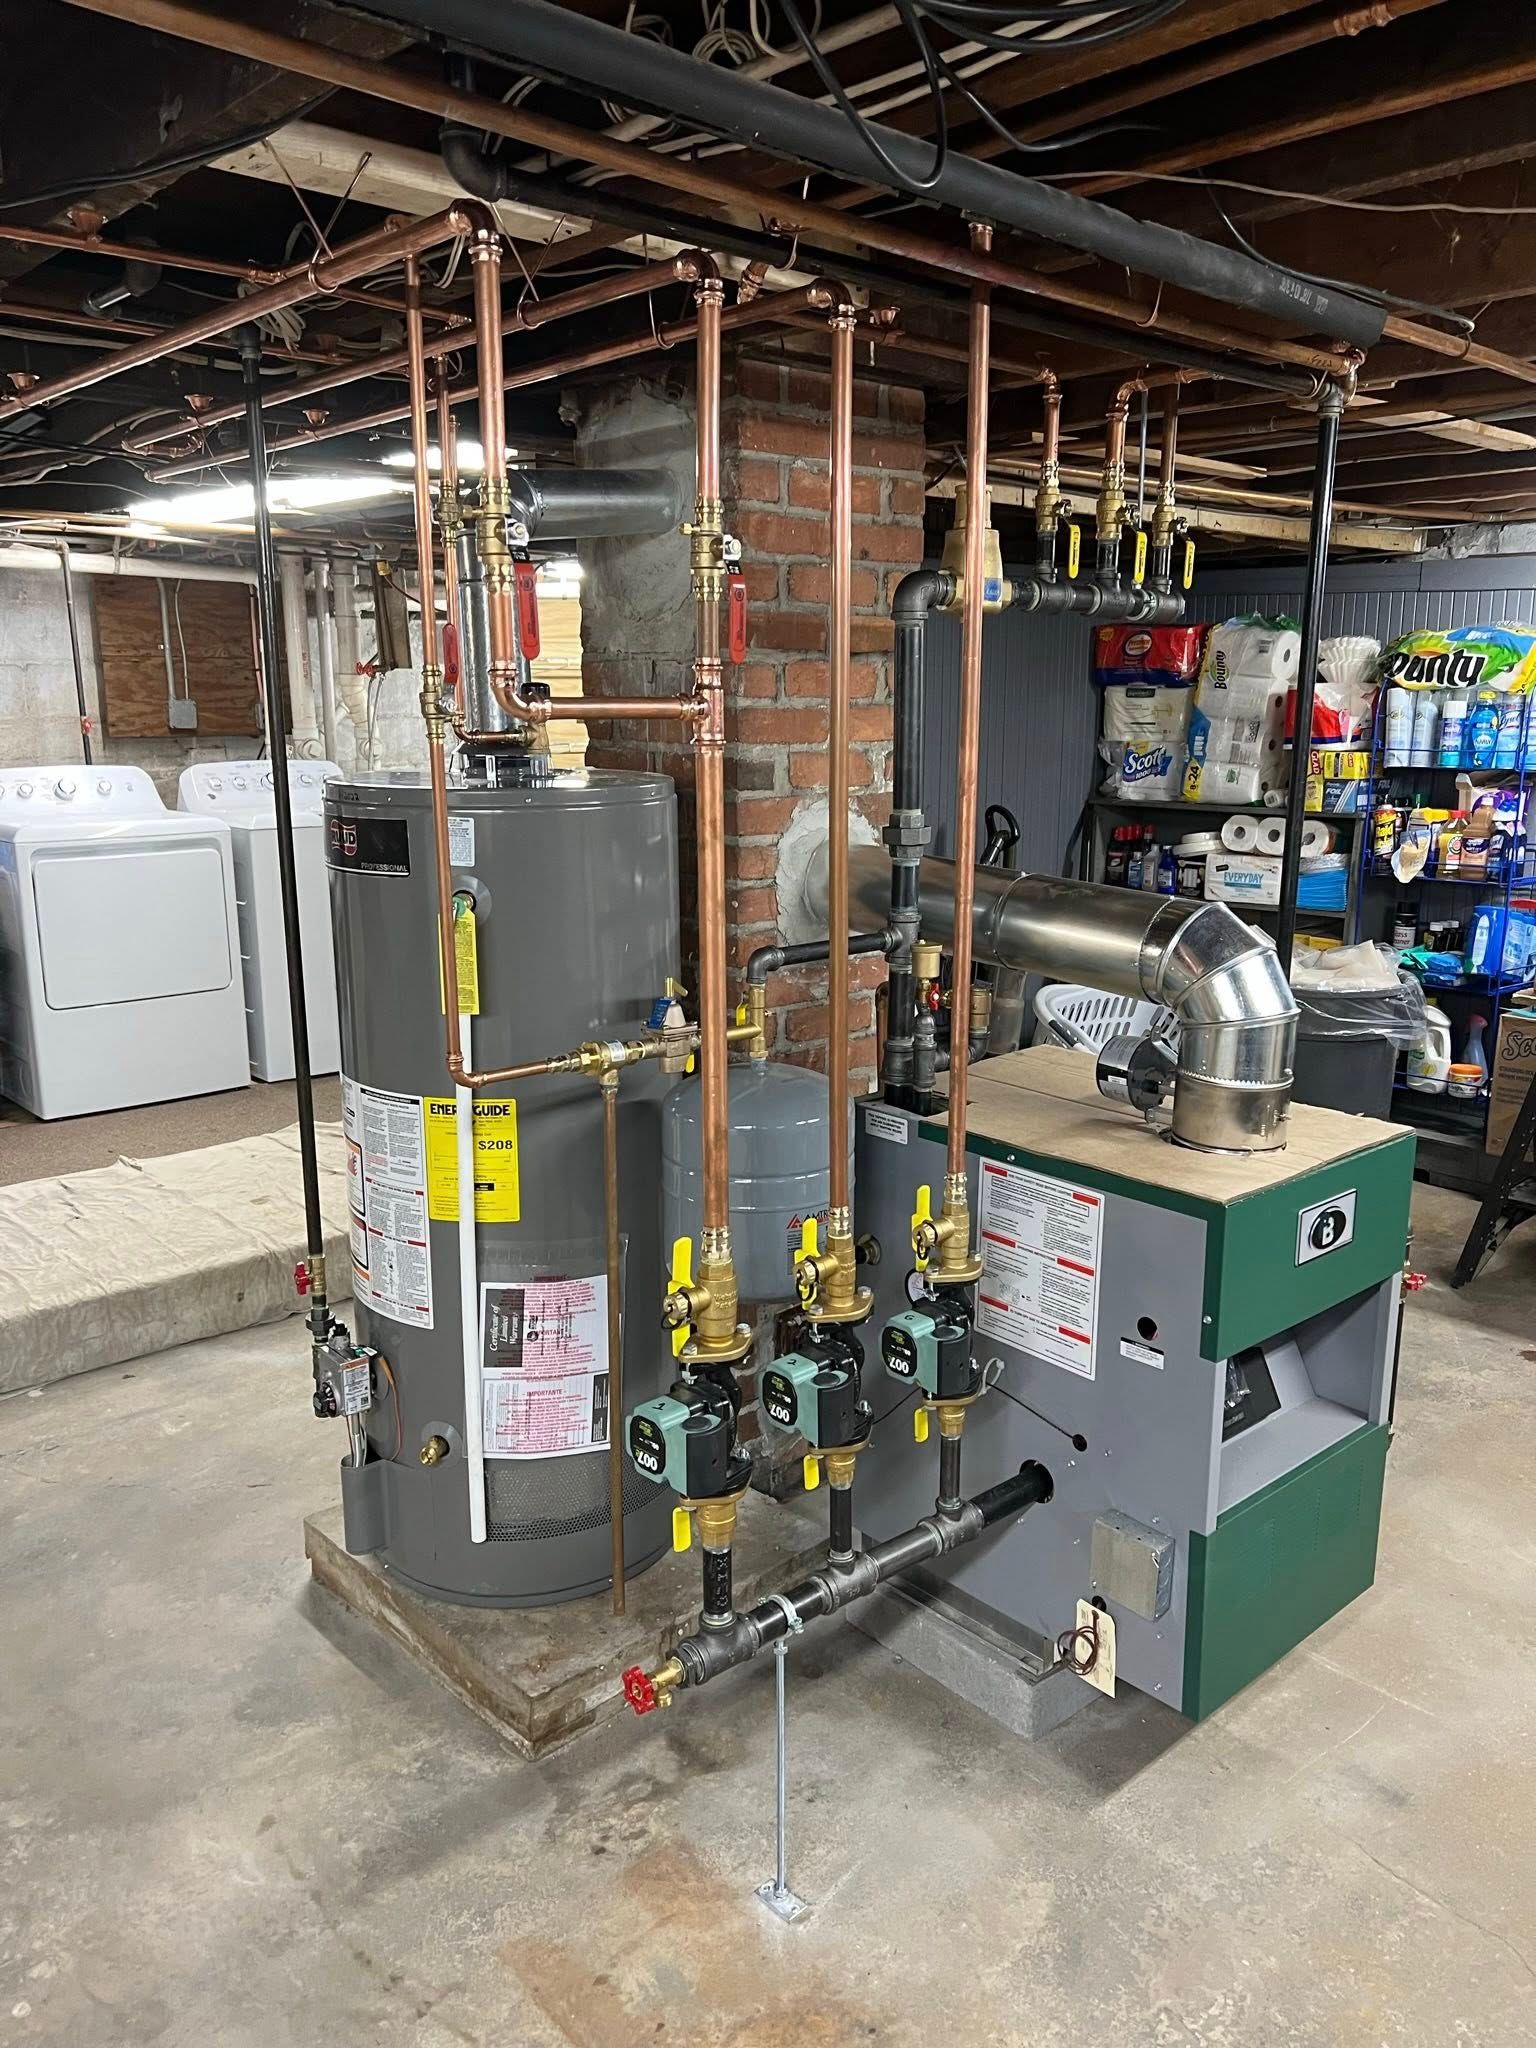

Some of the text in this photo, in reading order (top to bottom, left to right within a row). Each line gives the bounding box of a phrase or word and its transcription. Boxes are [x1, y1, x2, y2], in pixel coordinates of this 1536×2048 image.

[1214, 650, 1228, 690] Bounty
[1385, 649, 1486, 687] ounty
[1125, 744, 1166, 773] Scott
[1311, 751, 1320, 774] GLAD
[361, 862, 408, 872] PROFESSIONAL
[1224, 871, 1264, 883] EVERYDAY
[478, 1140, 513, 1150] $208
[1322, 1216, 1335, 1246] B
